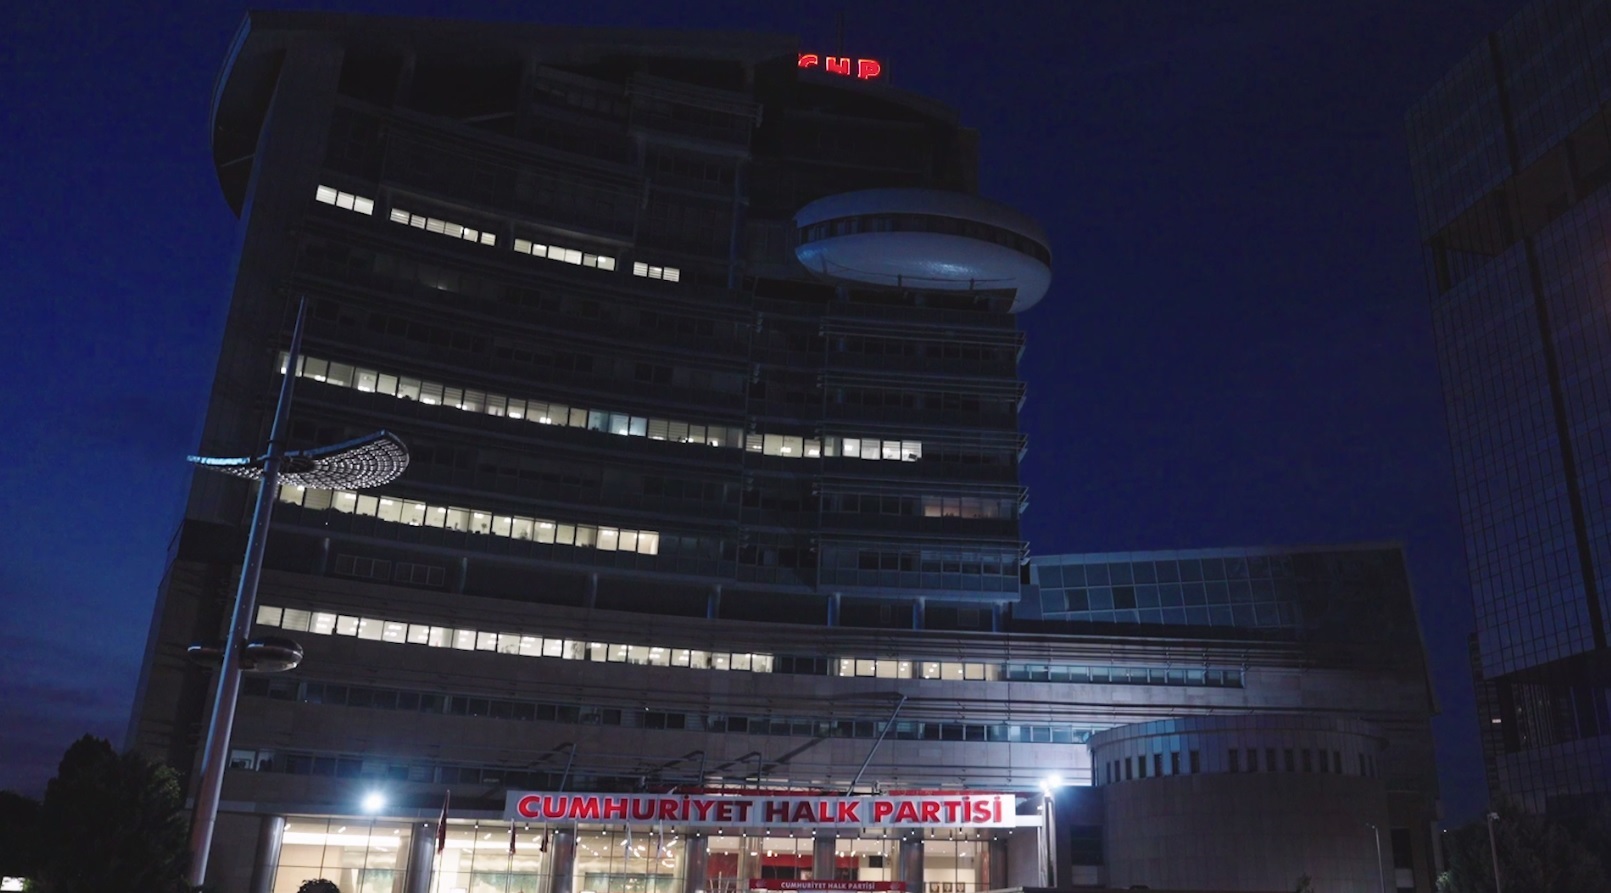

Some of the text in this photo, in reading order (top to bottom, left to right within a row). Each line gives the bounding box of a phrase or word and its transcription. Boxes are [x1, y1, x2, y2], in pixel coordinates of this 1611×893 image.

[517, 795, 1003, 823] CUMHURİYET HALK PARTİSİ
[780, 881, 826, 890] CUMHURİYET
[848, 882, 875, 890] PARTİSİ
